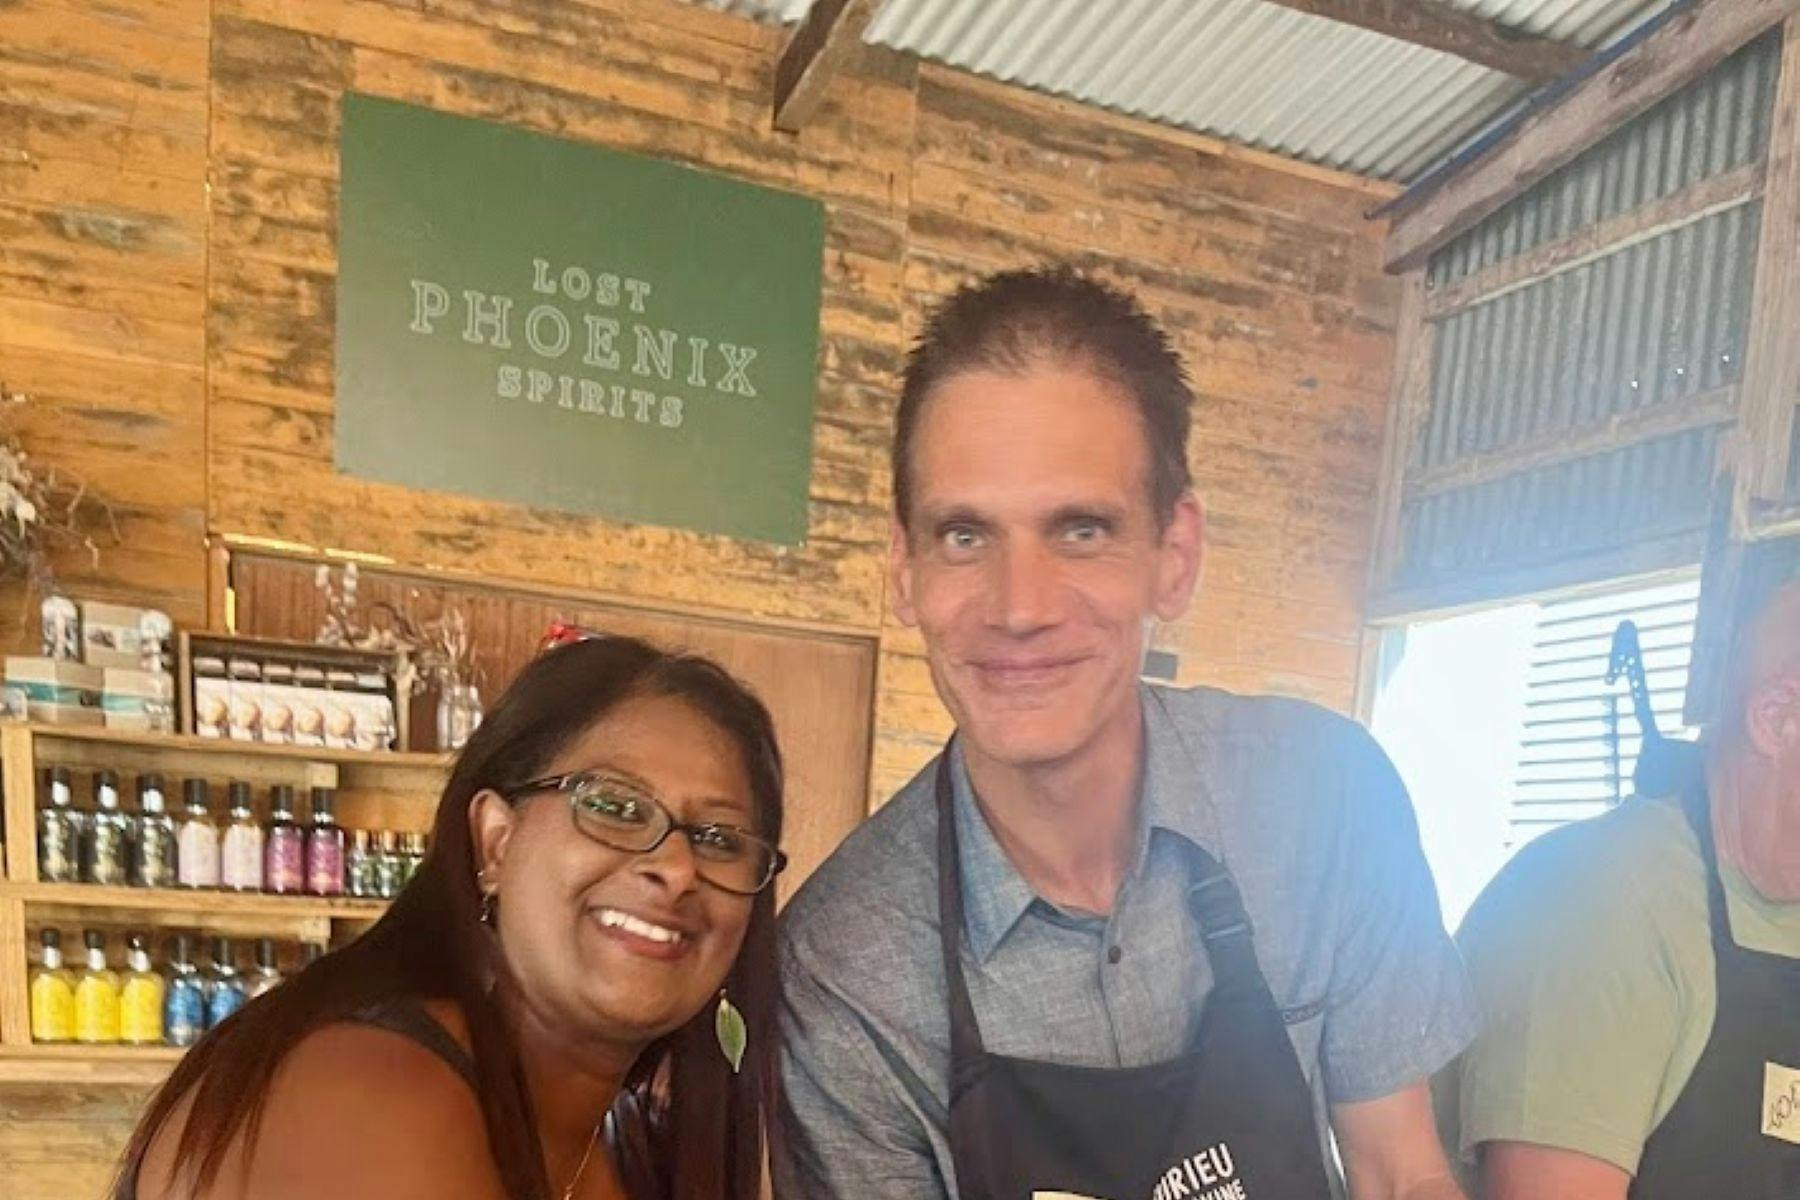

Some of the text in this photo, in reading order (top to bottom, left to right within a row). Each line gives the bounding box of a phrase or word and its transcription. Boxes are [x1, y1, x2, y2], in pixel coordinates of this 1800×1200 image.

[532, 257, 651, 314] LOST
[409, 279, 758, 398] PHOENIX
[497, 365, 684, 429] SPIRITS
